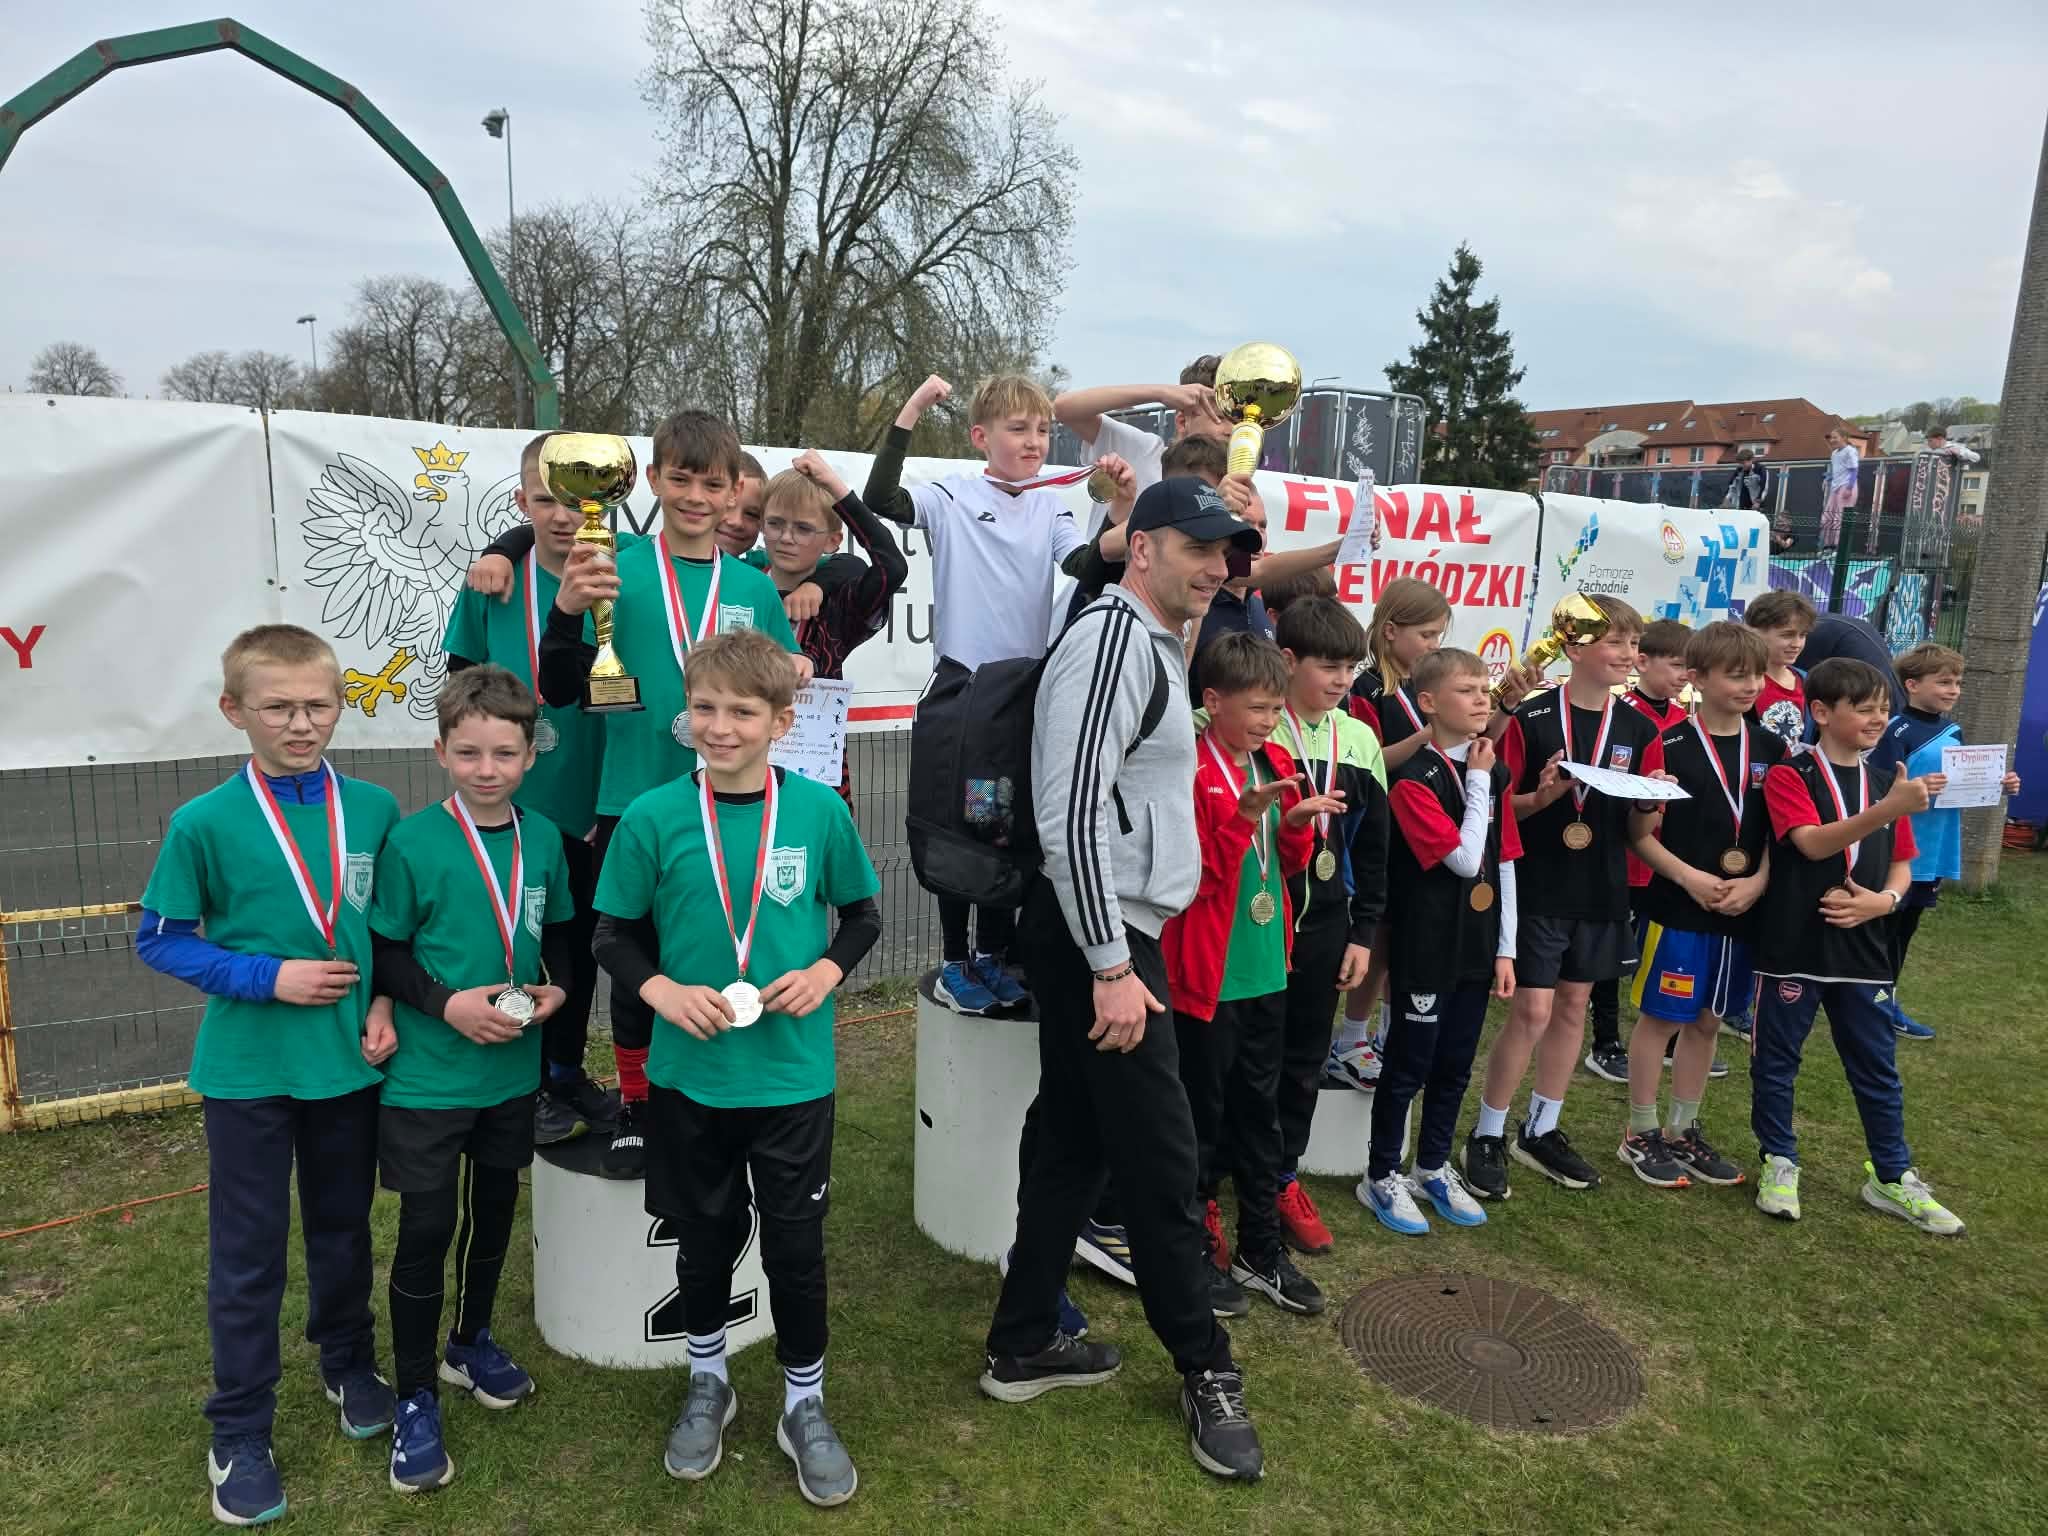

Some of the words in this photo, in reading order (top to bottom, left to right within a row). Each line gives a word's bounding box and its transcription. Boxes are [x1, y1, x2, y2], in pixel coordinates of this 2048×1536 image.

[1283, 480, 1491, 544] FINAŁ
[1589, 564, 1634, 579] Pomorze
[1577, 579, 1629, 593] Zachodnie
[611, 1136, 644, 1151] PUMA
[687, 1398, 717, 1418] NIKE
